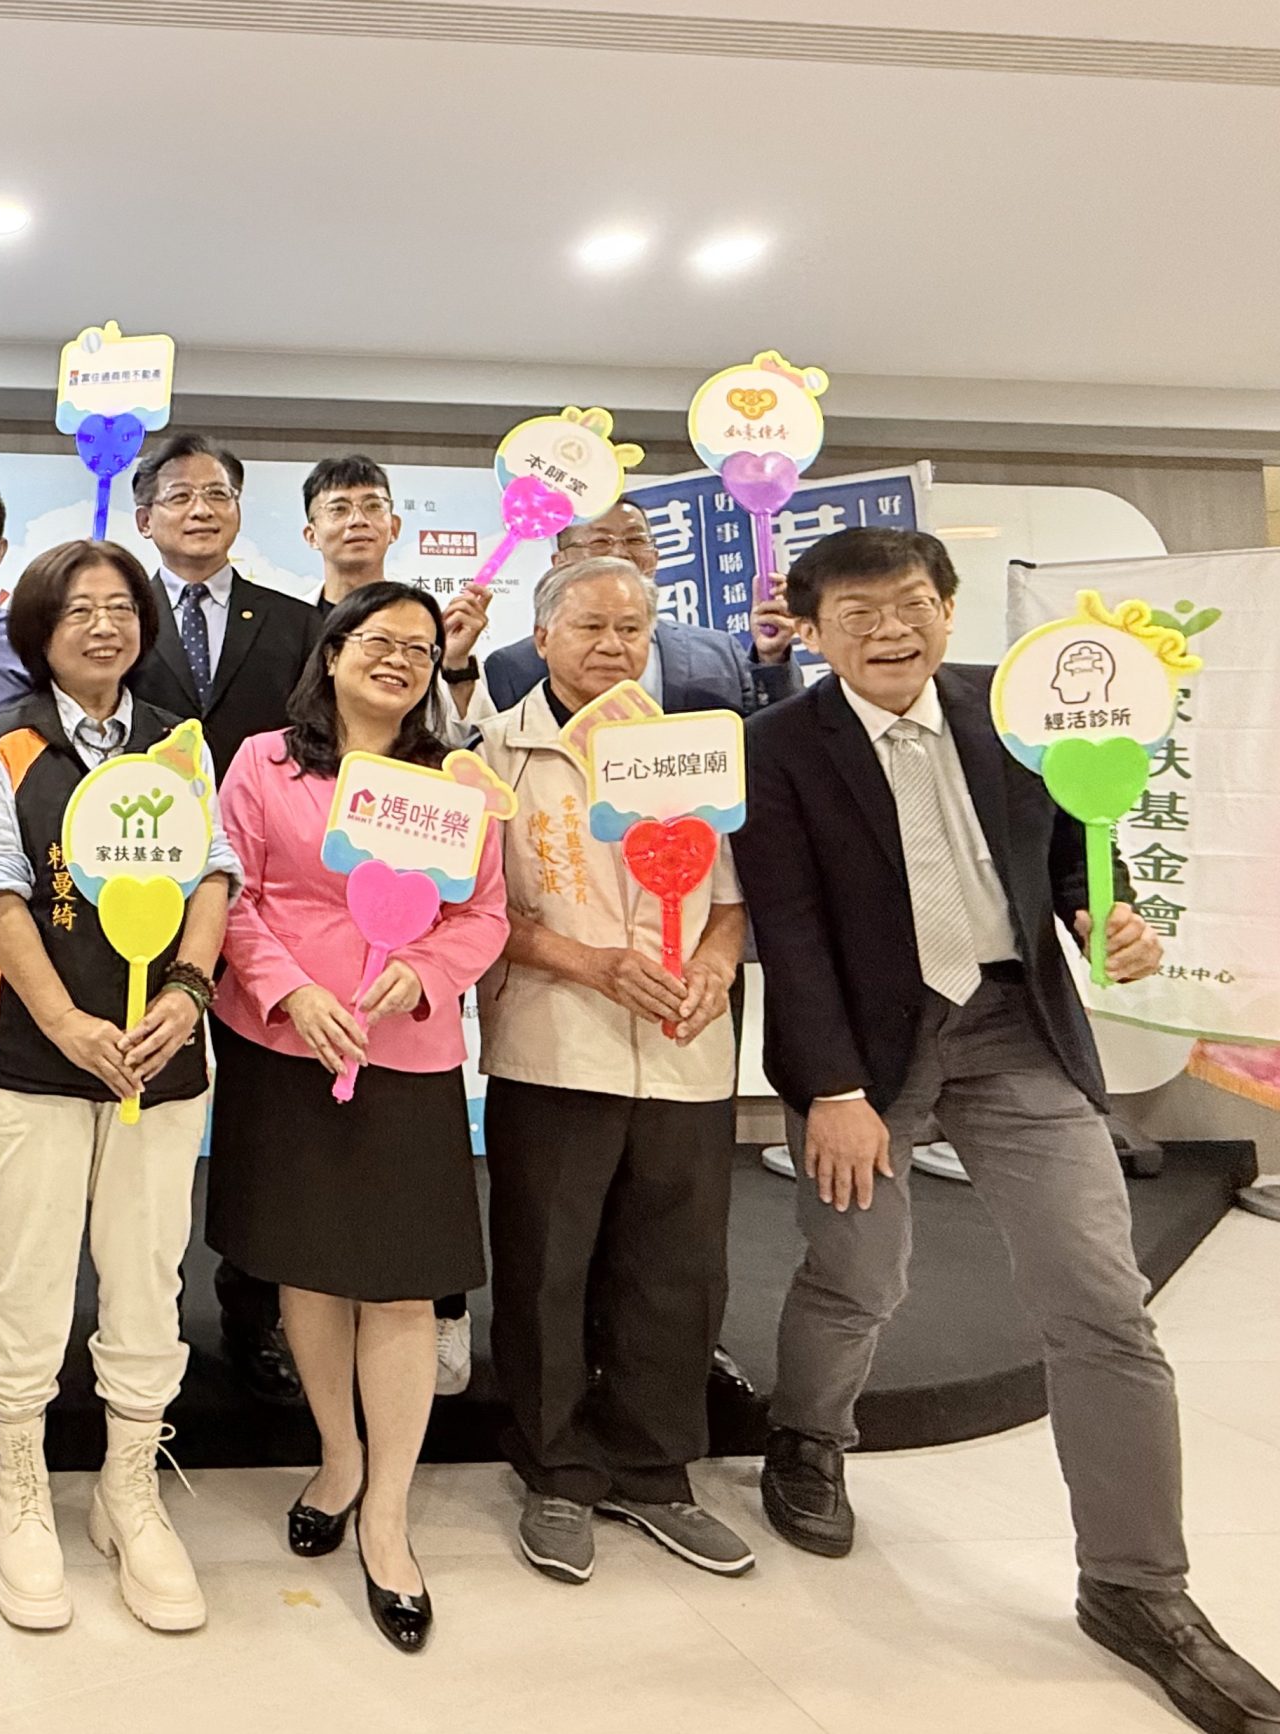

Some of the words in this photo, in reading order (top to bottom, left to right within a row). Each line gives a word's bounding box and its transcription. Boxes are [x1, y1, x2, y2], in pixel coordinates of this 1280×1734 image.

[525, 453, 588, 497] 本師堂
[1044, 708, 1132, 731] 經活診所
[601, 750, 728, 783] 仁心城隍廟
[377, 794, 470, 839] 媽咪樂
[95, 846, 183, 862] 家扶基金會
